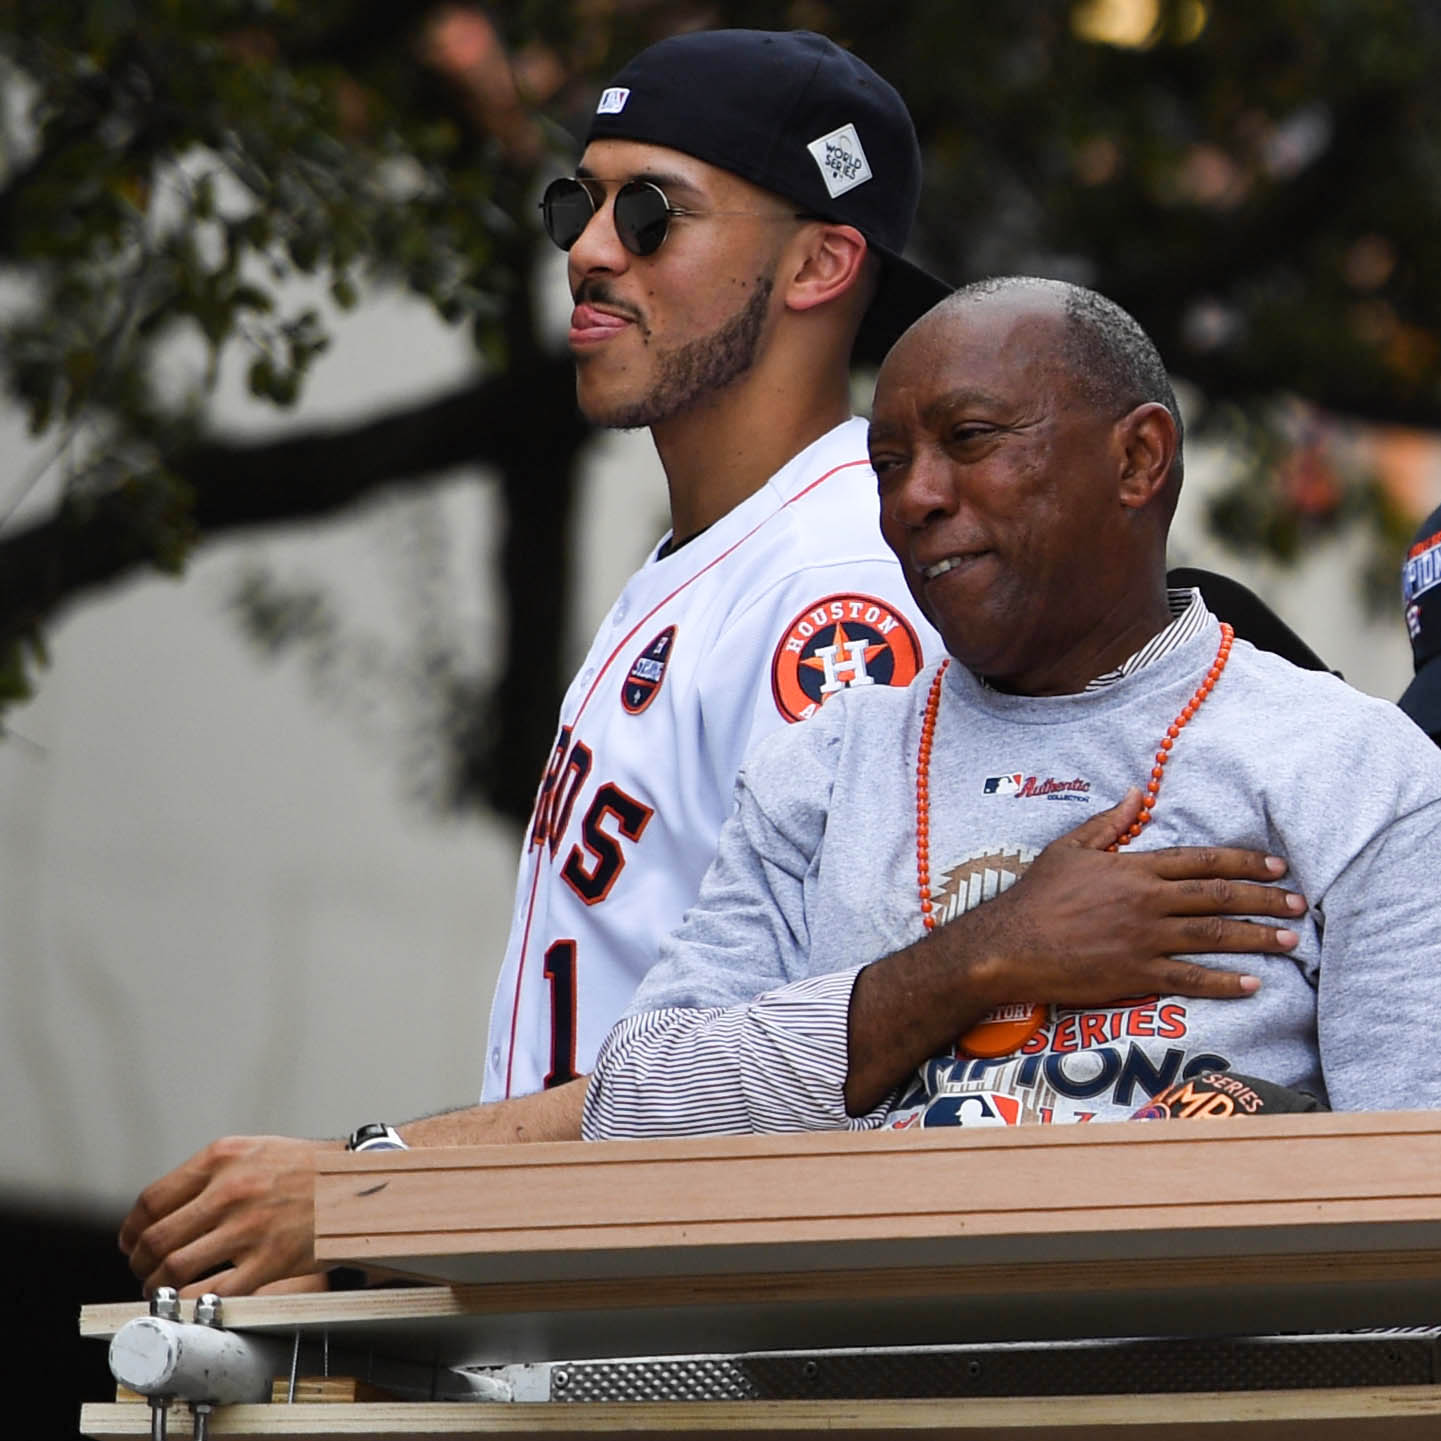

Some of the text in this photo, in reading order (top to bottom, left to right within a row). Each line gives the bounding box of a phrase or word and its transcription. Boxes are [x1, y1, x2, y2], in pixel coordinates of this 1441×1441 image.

[825, 142, 862, 169] WORLD
[825, 154, 856, 180] SERIES
[784, 601, 900, 655] HOUSTON
[814, 638, 875, 694] H
[1014, 776, 1091, 799] Authentic
[543, 939, 583, 1090] 1
[1020, 1004, 1187, 1054] SERIES
[1201, 1073, 1265, 1113] SERIES
